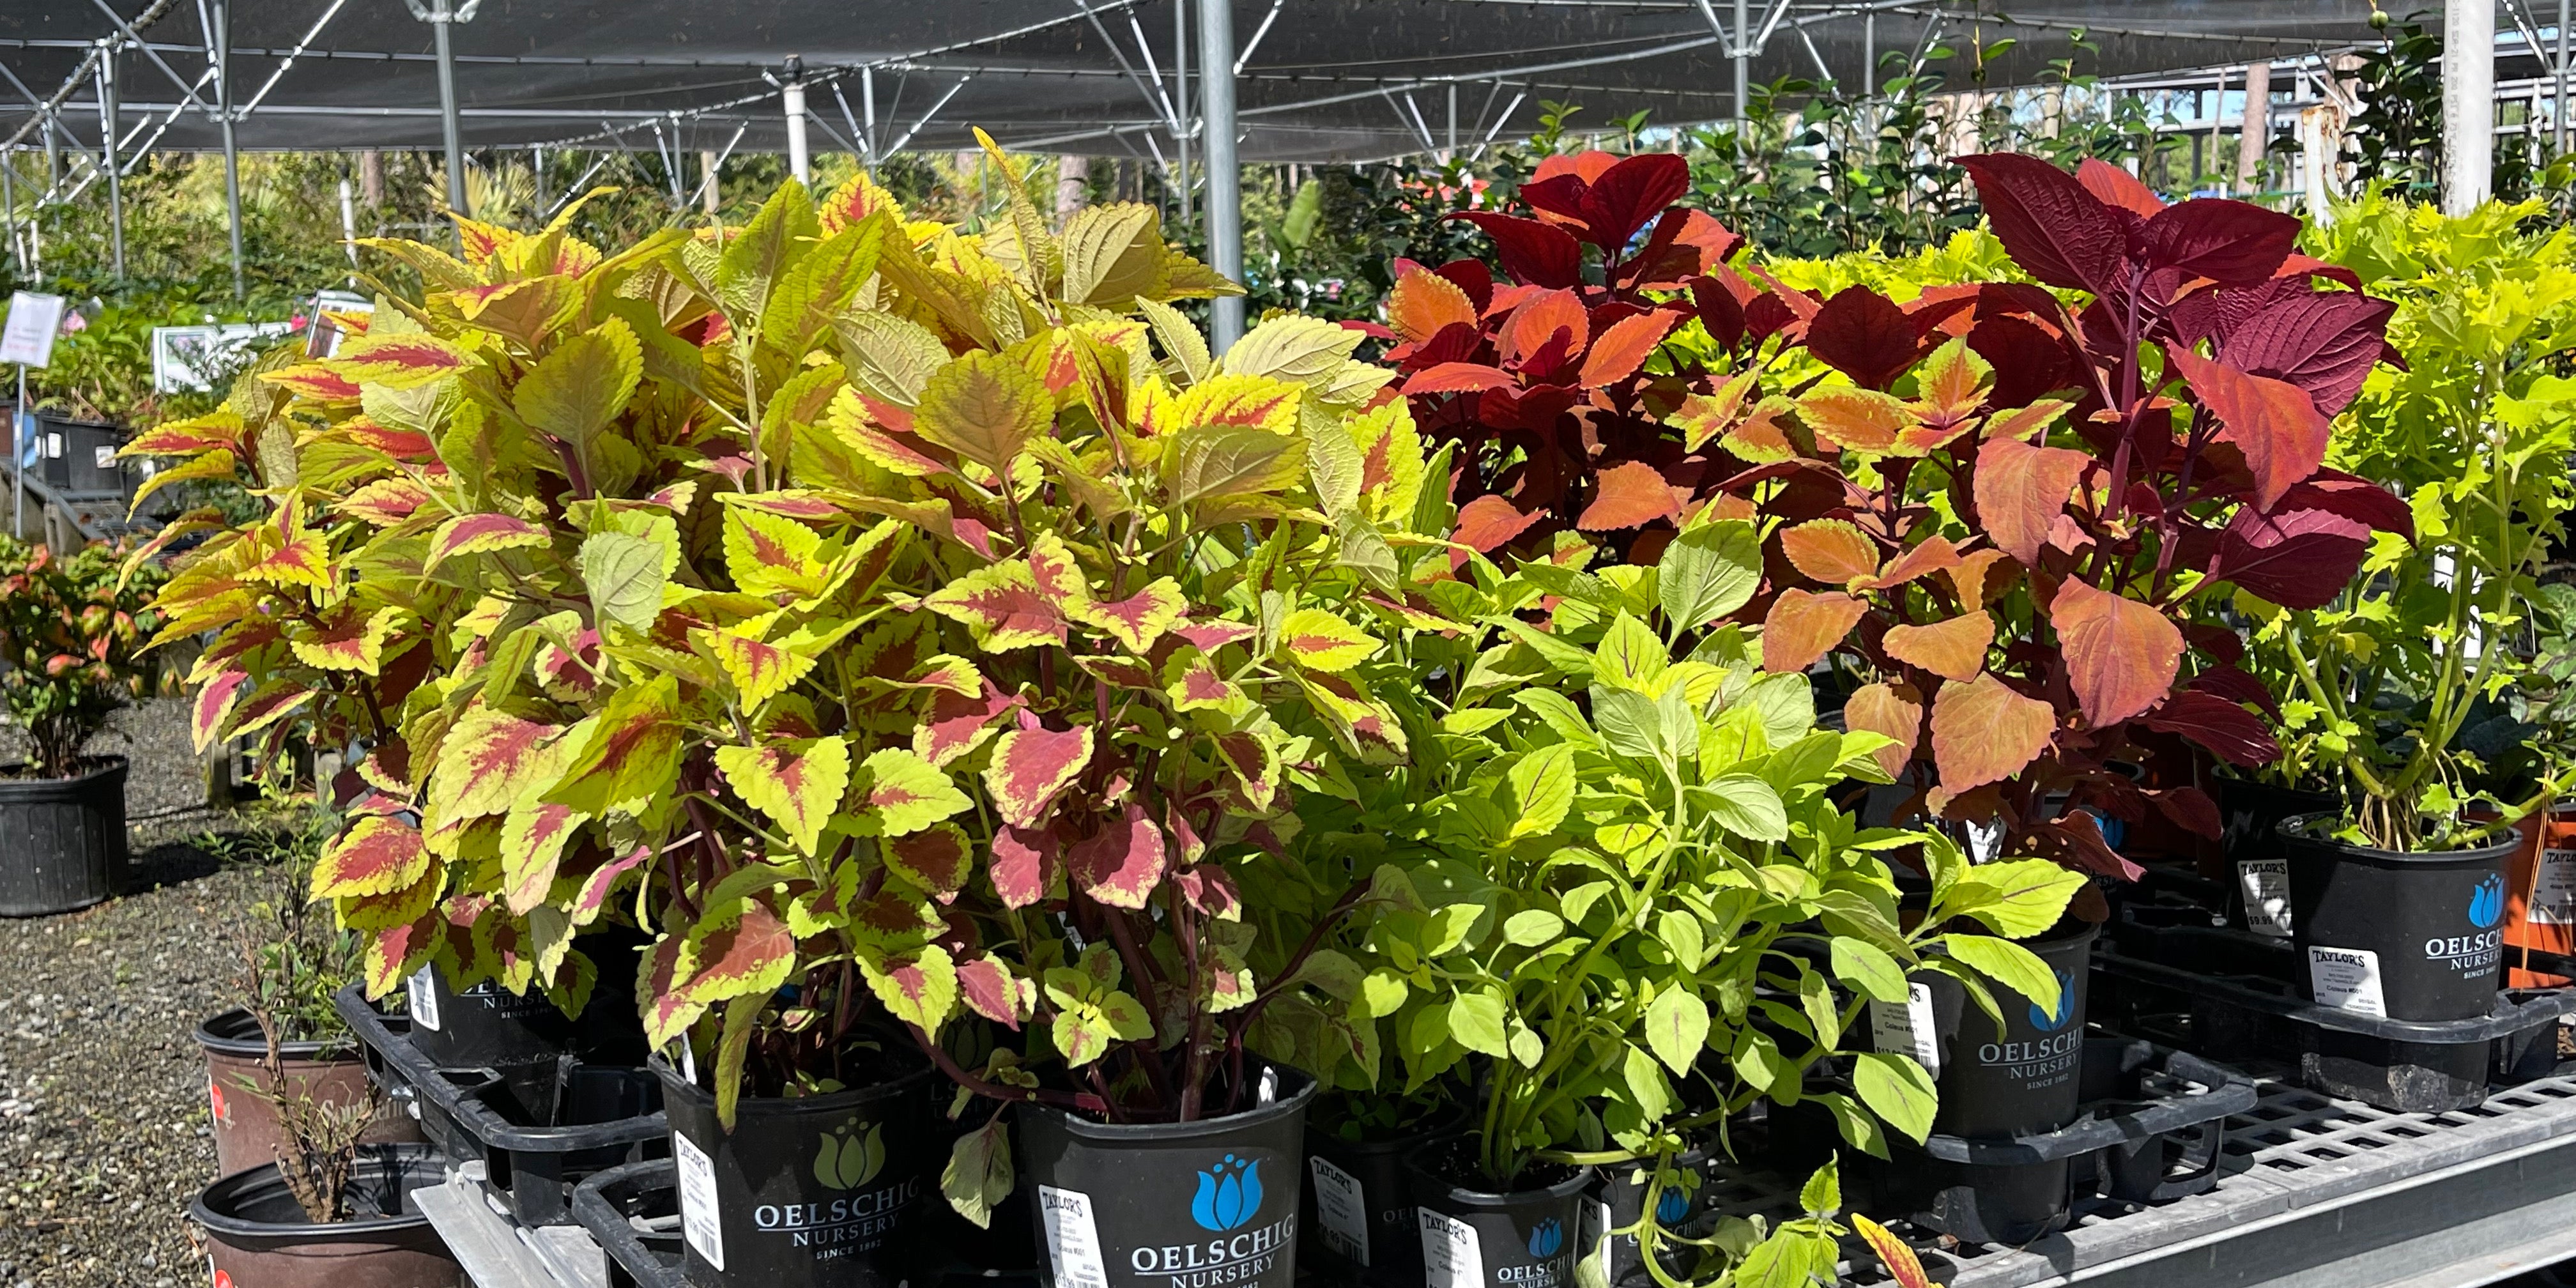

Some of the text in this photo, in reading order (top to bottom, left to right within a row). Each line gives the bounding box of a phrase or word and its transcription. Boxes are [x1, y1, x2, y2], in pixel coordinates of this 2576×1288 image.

[2241, 863, 2287, 876] TAYLOR'S
[2312, 950, 2365, 968] TAYLOR'S
[2464, 969, 2485, 979] SINCE
[2027, 1080, 2052, 1091] SINCE
[1314, 1159, 1353, 1195] TAYLOR'S
[755, 1175, 919, 1228] OELSCHIG
[1043, 1191, 1083, 1218] TAYLOR'S
[792, 1212, 898, 1247] NURSERY
[1131, 1213, 1294, 1271] OELSCHIG
[1423, 1213, 1468, 1245] TAYLOR'S
[816, 1245, 854, 1260] SINCE
[1171, 1252, 1275, 1288] NURSERY
